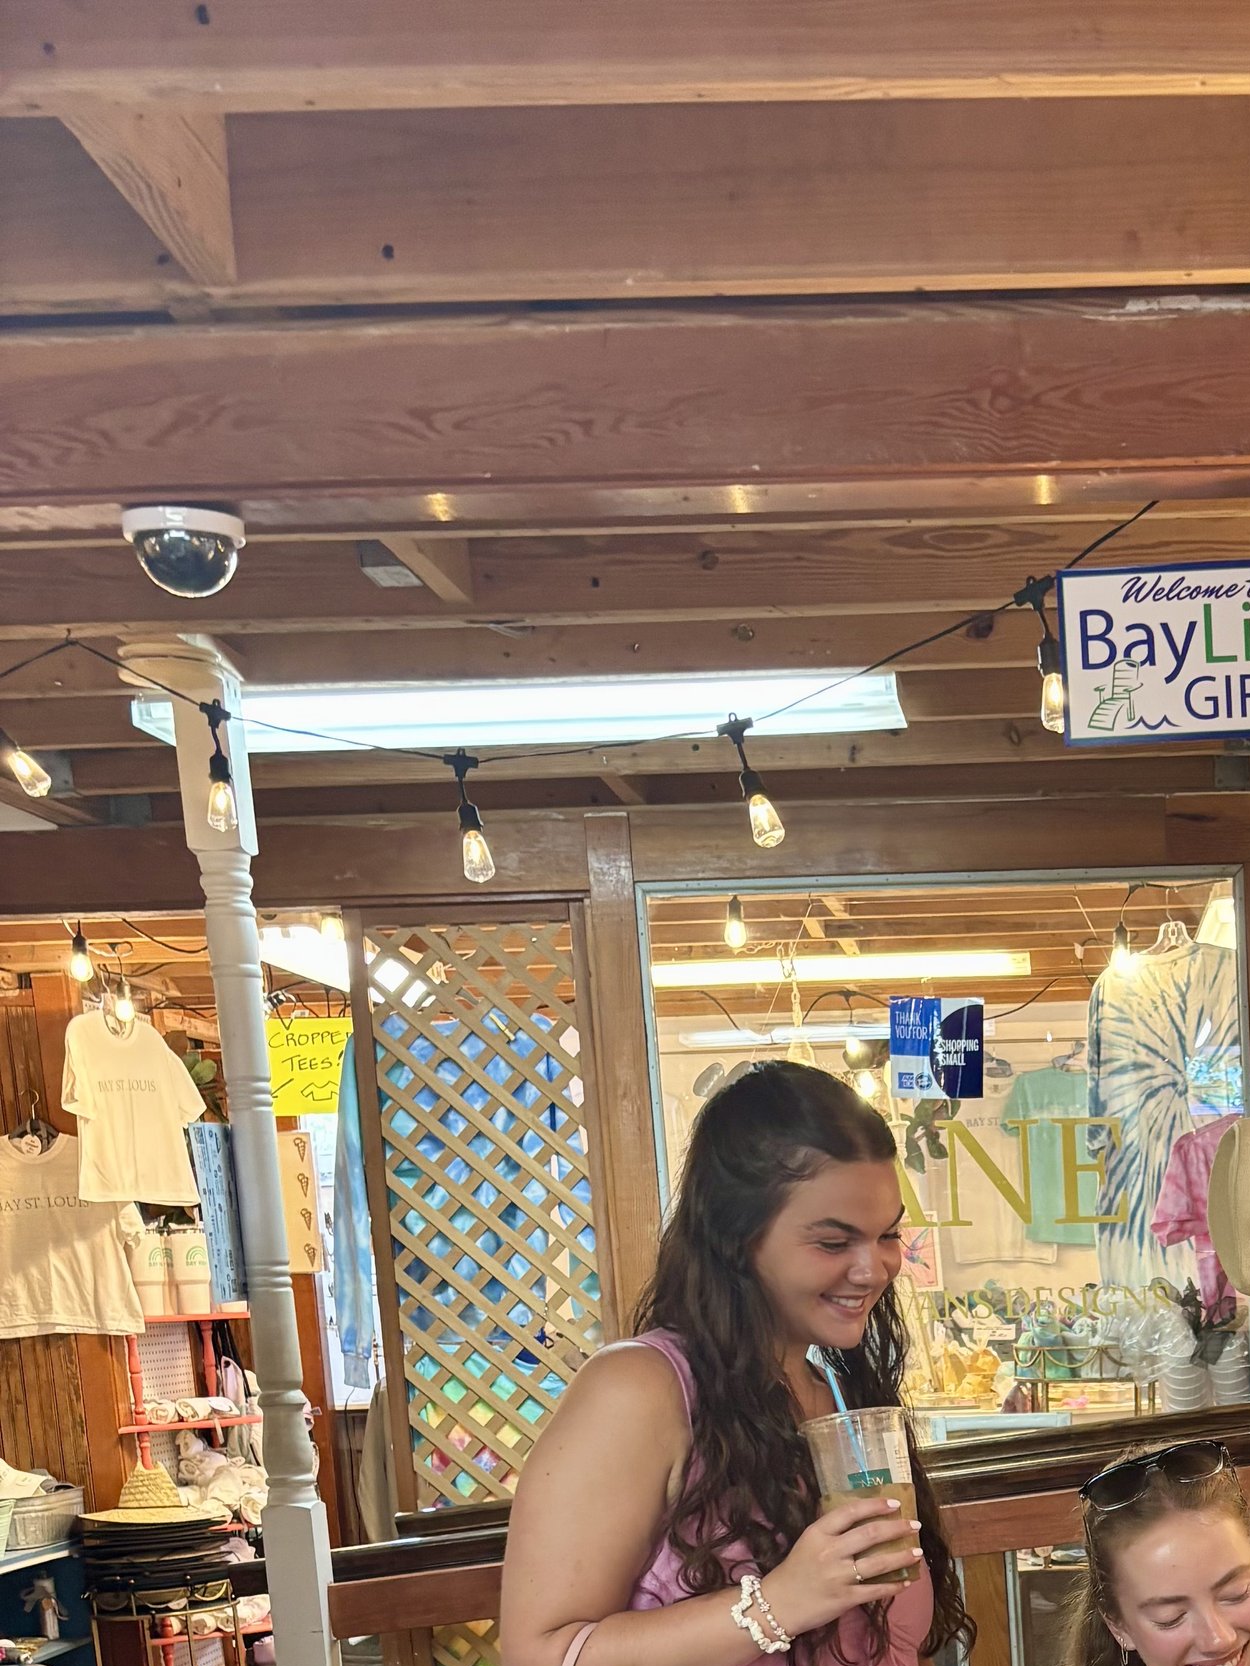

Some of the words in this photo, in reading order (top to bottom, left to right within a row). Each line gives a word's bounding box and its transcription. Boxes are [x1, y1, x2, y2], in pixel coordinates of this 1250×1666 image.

[1121, 575, 1245, 604] Welcome
[895, 1011, 922, 1026] THANK
[895, 1026, 912, 1040] YOU
[912, 1026, 928, 1040] FOR
[941, 1039, 979, 1052] SHOPPING
[282, 1050, 344, 1072] TEES!
[941, 1053, 966, 1066] SMALL
[128, 1078, 157, 1092] LOUIS
[0, 1199, 21, 1211] AY
[45, 1195, 89, 1209] LOUIS
[1004, 1283, 1172, 1320] DESIGNS
